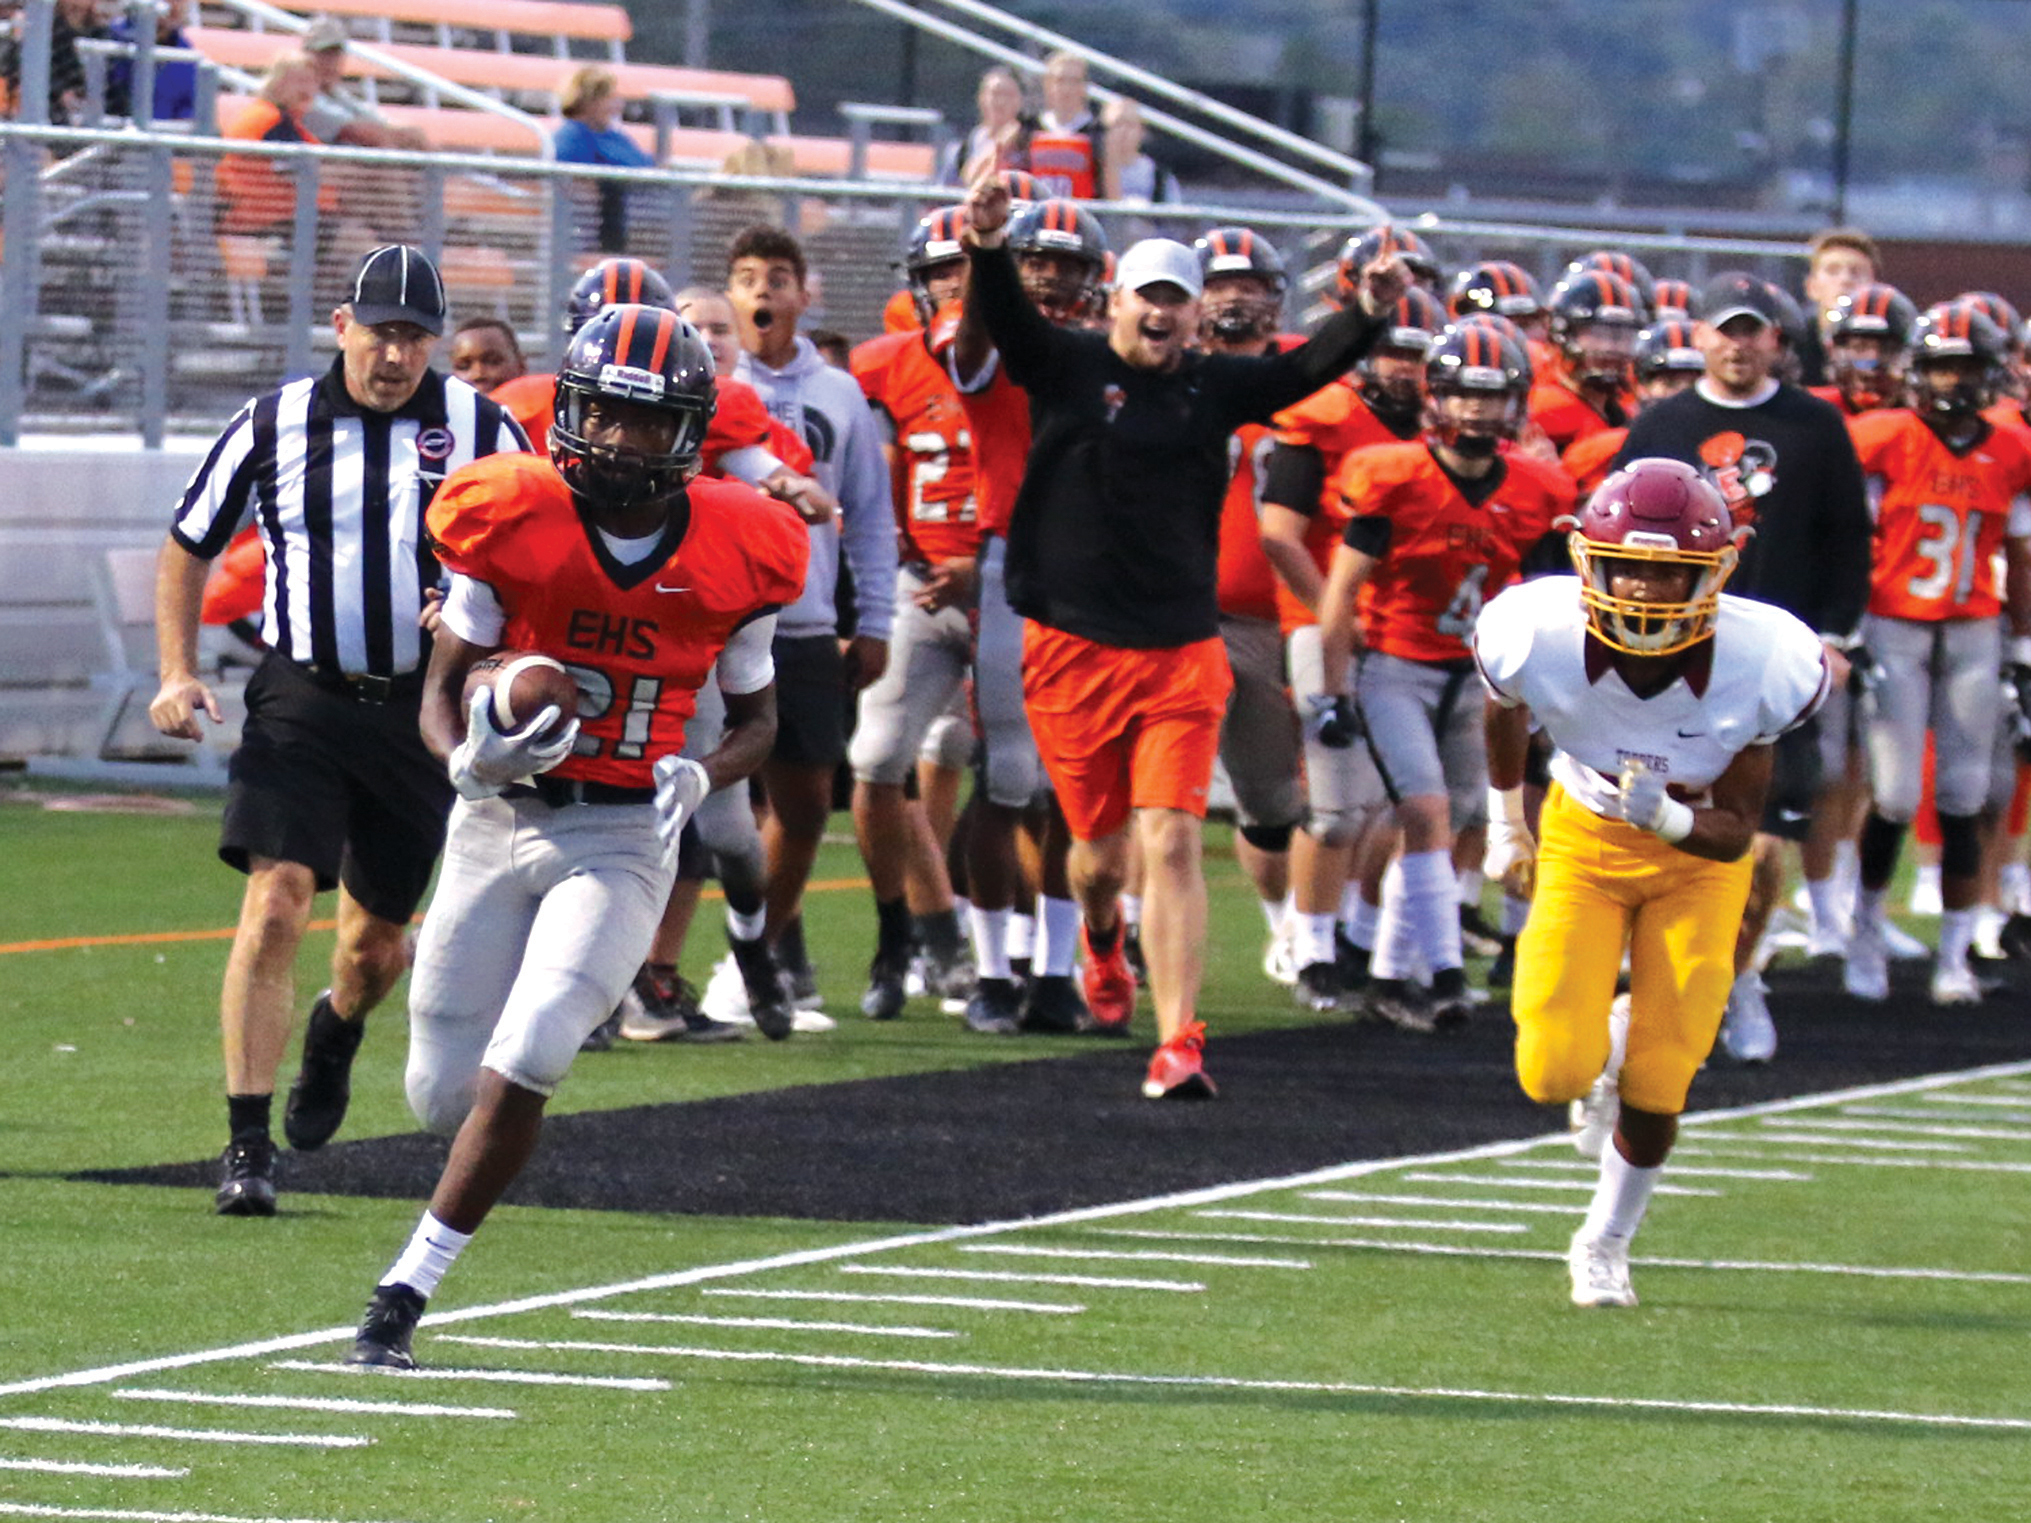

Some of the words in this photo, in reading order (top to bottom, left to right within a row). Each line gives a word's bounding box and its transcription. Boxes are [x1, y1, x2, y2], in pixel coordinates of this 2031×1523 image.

[1908, 504, 1983, 604] 31
[566, 608, 660, 660] EHS
[1436, 561, 1489, 648] 4
